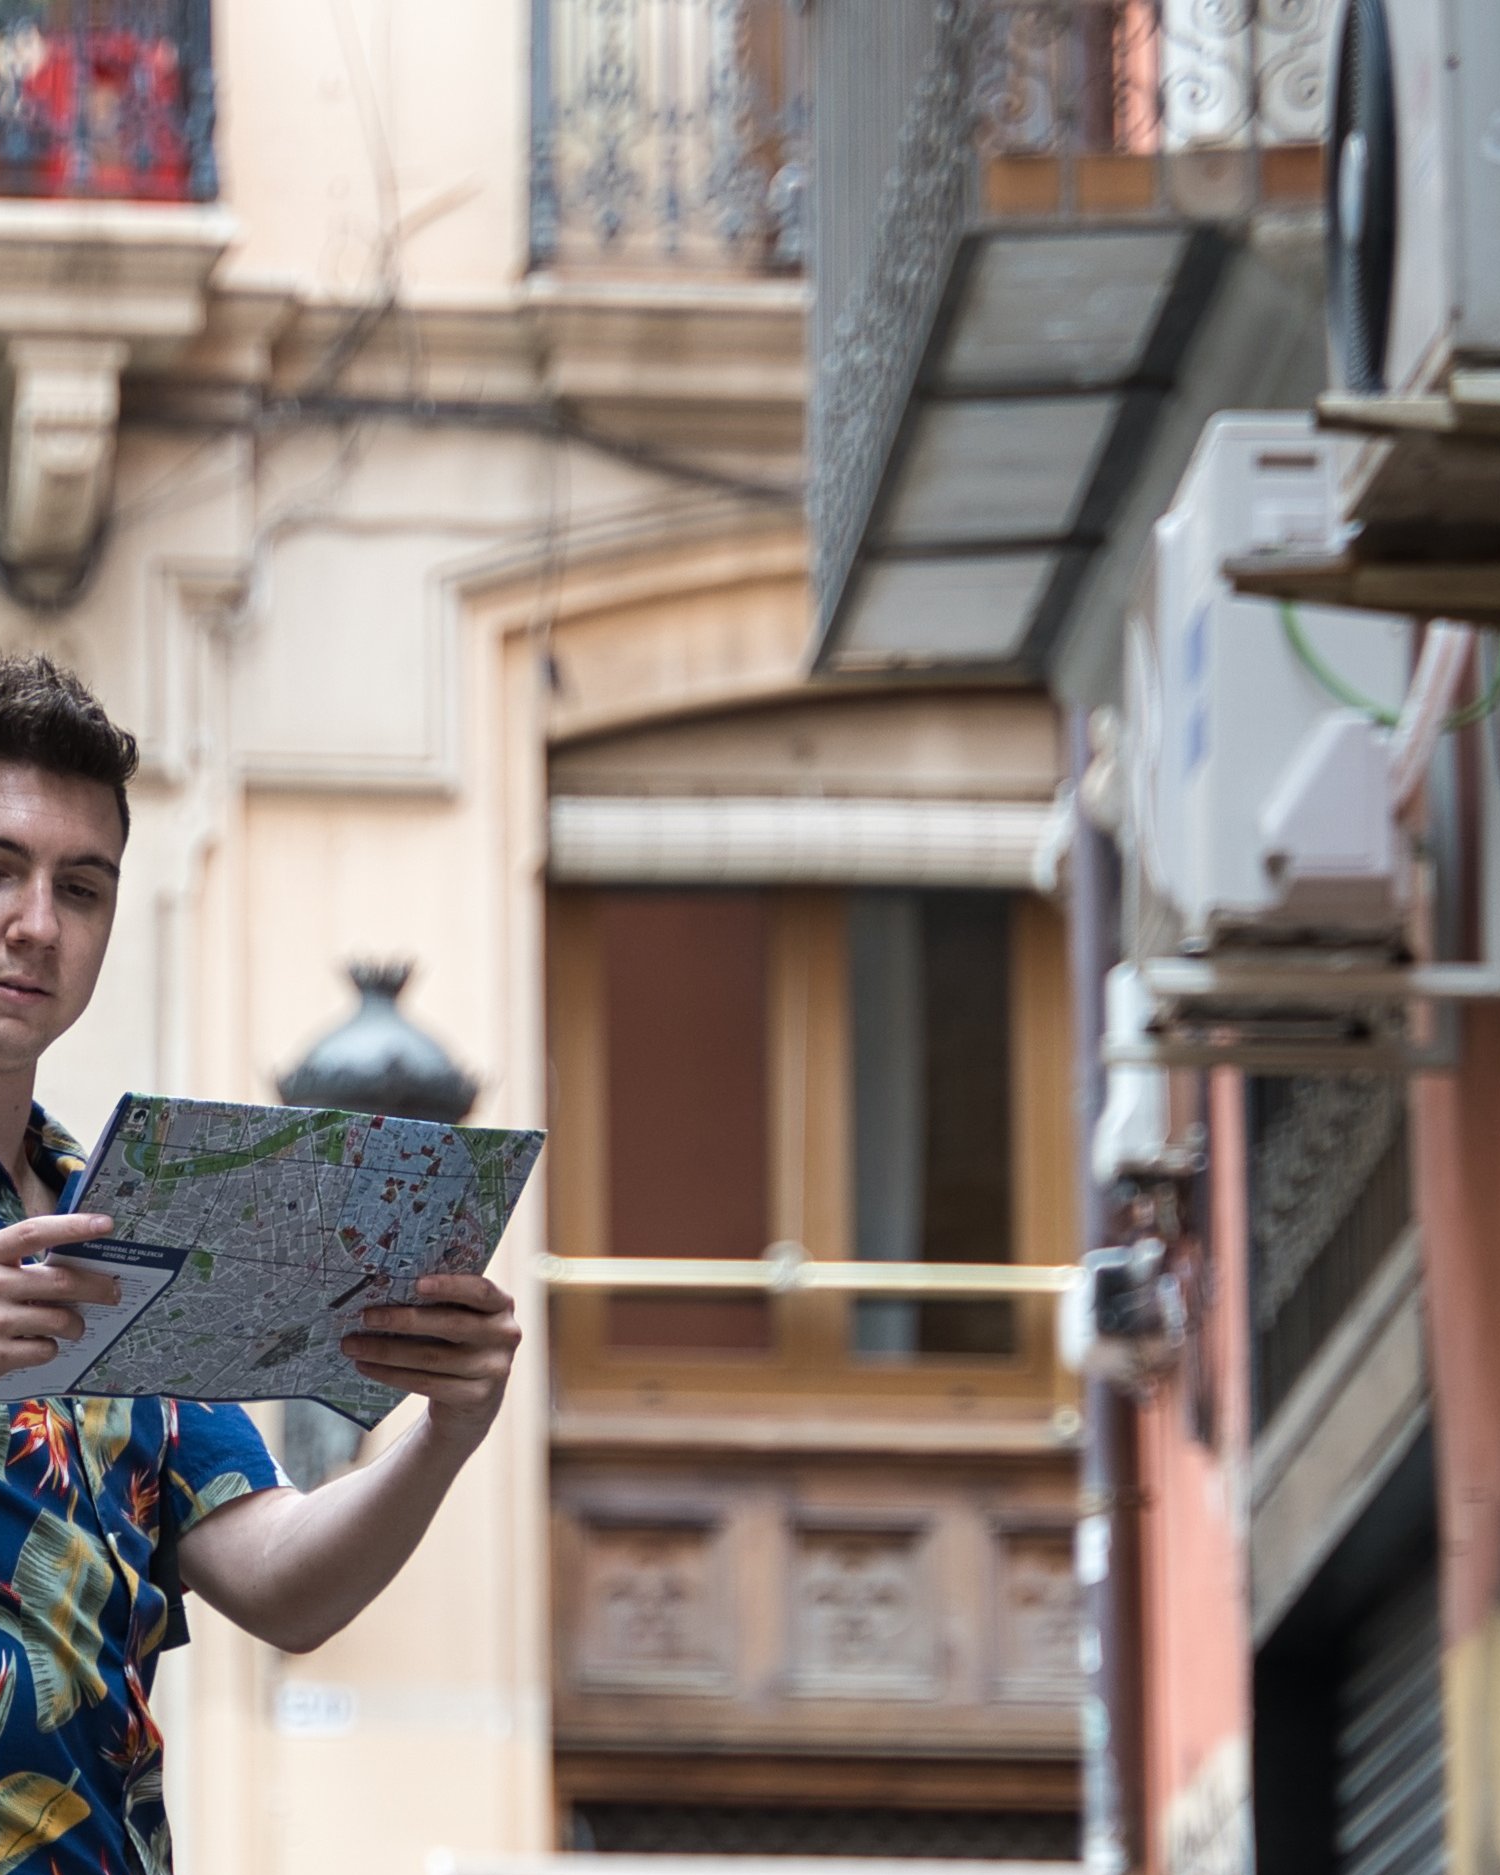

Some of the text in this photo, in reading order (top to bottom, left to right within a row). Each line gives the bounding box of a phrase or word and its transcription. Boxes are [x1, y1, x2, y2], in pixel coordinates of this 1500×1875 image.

[102, 1251, 126, 1260] GENERAL
[103, 1244, 128, 1254] GENERAL
[137, 1249, 164, 1258] VALENCIA
